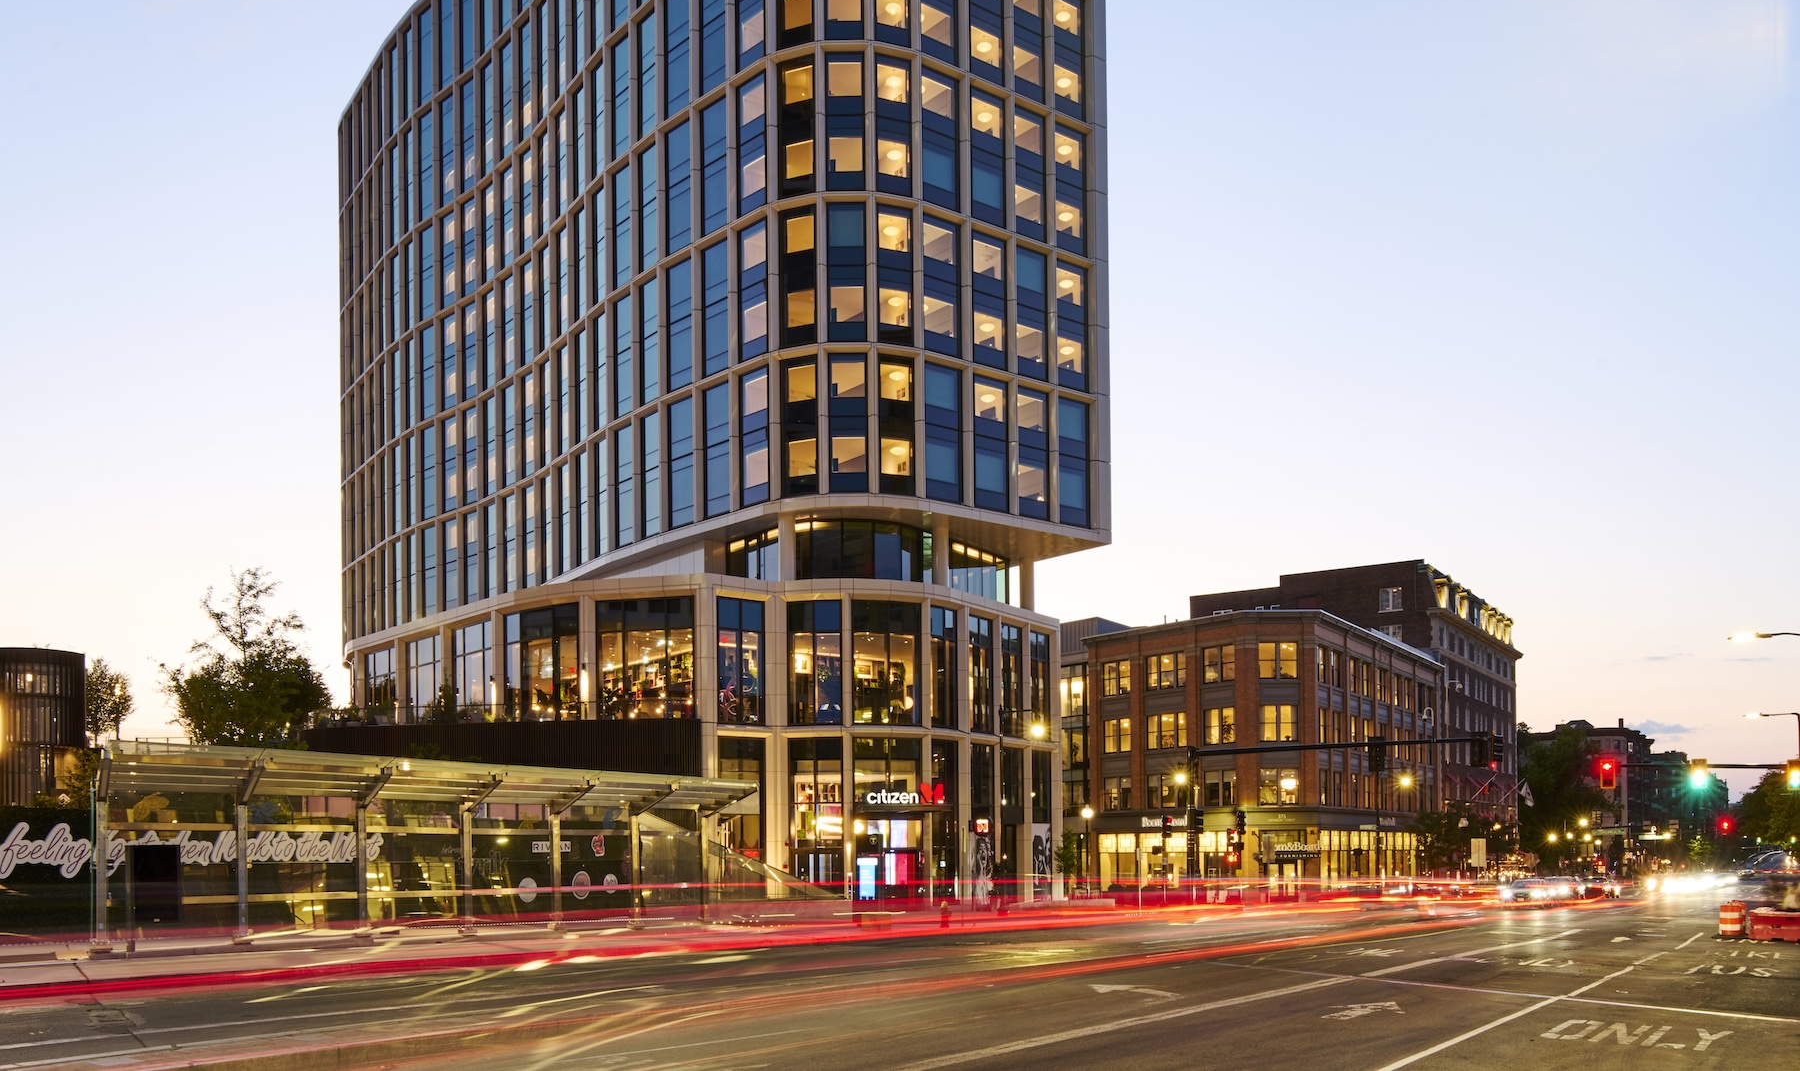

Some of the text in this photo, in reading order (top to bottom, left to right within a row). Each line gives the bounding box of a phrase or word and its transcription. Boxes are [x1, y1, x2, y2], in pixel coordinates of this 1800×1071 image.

[0, 825, 91, 875] feeling
[274, 833, 295, 859] to
[299, 833, 331, 859] the
[331, 832, 382, 860] Wet
[1540, 1019, 1734, 1052] ONLY
